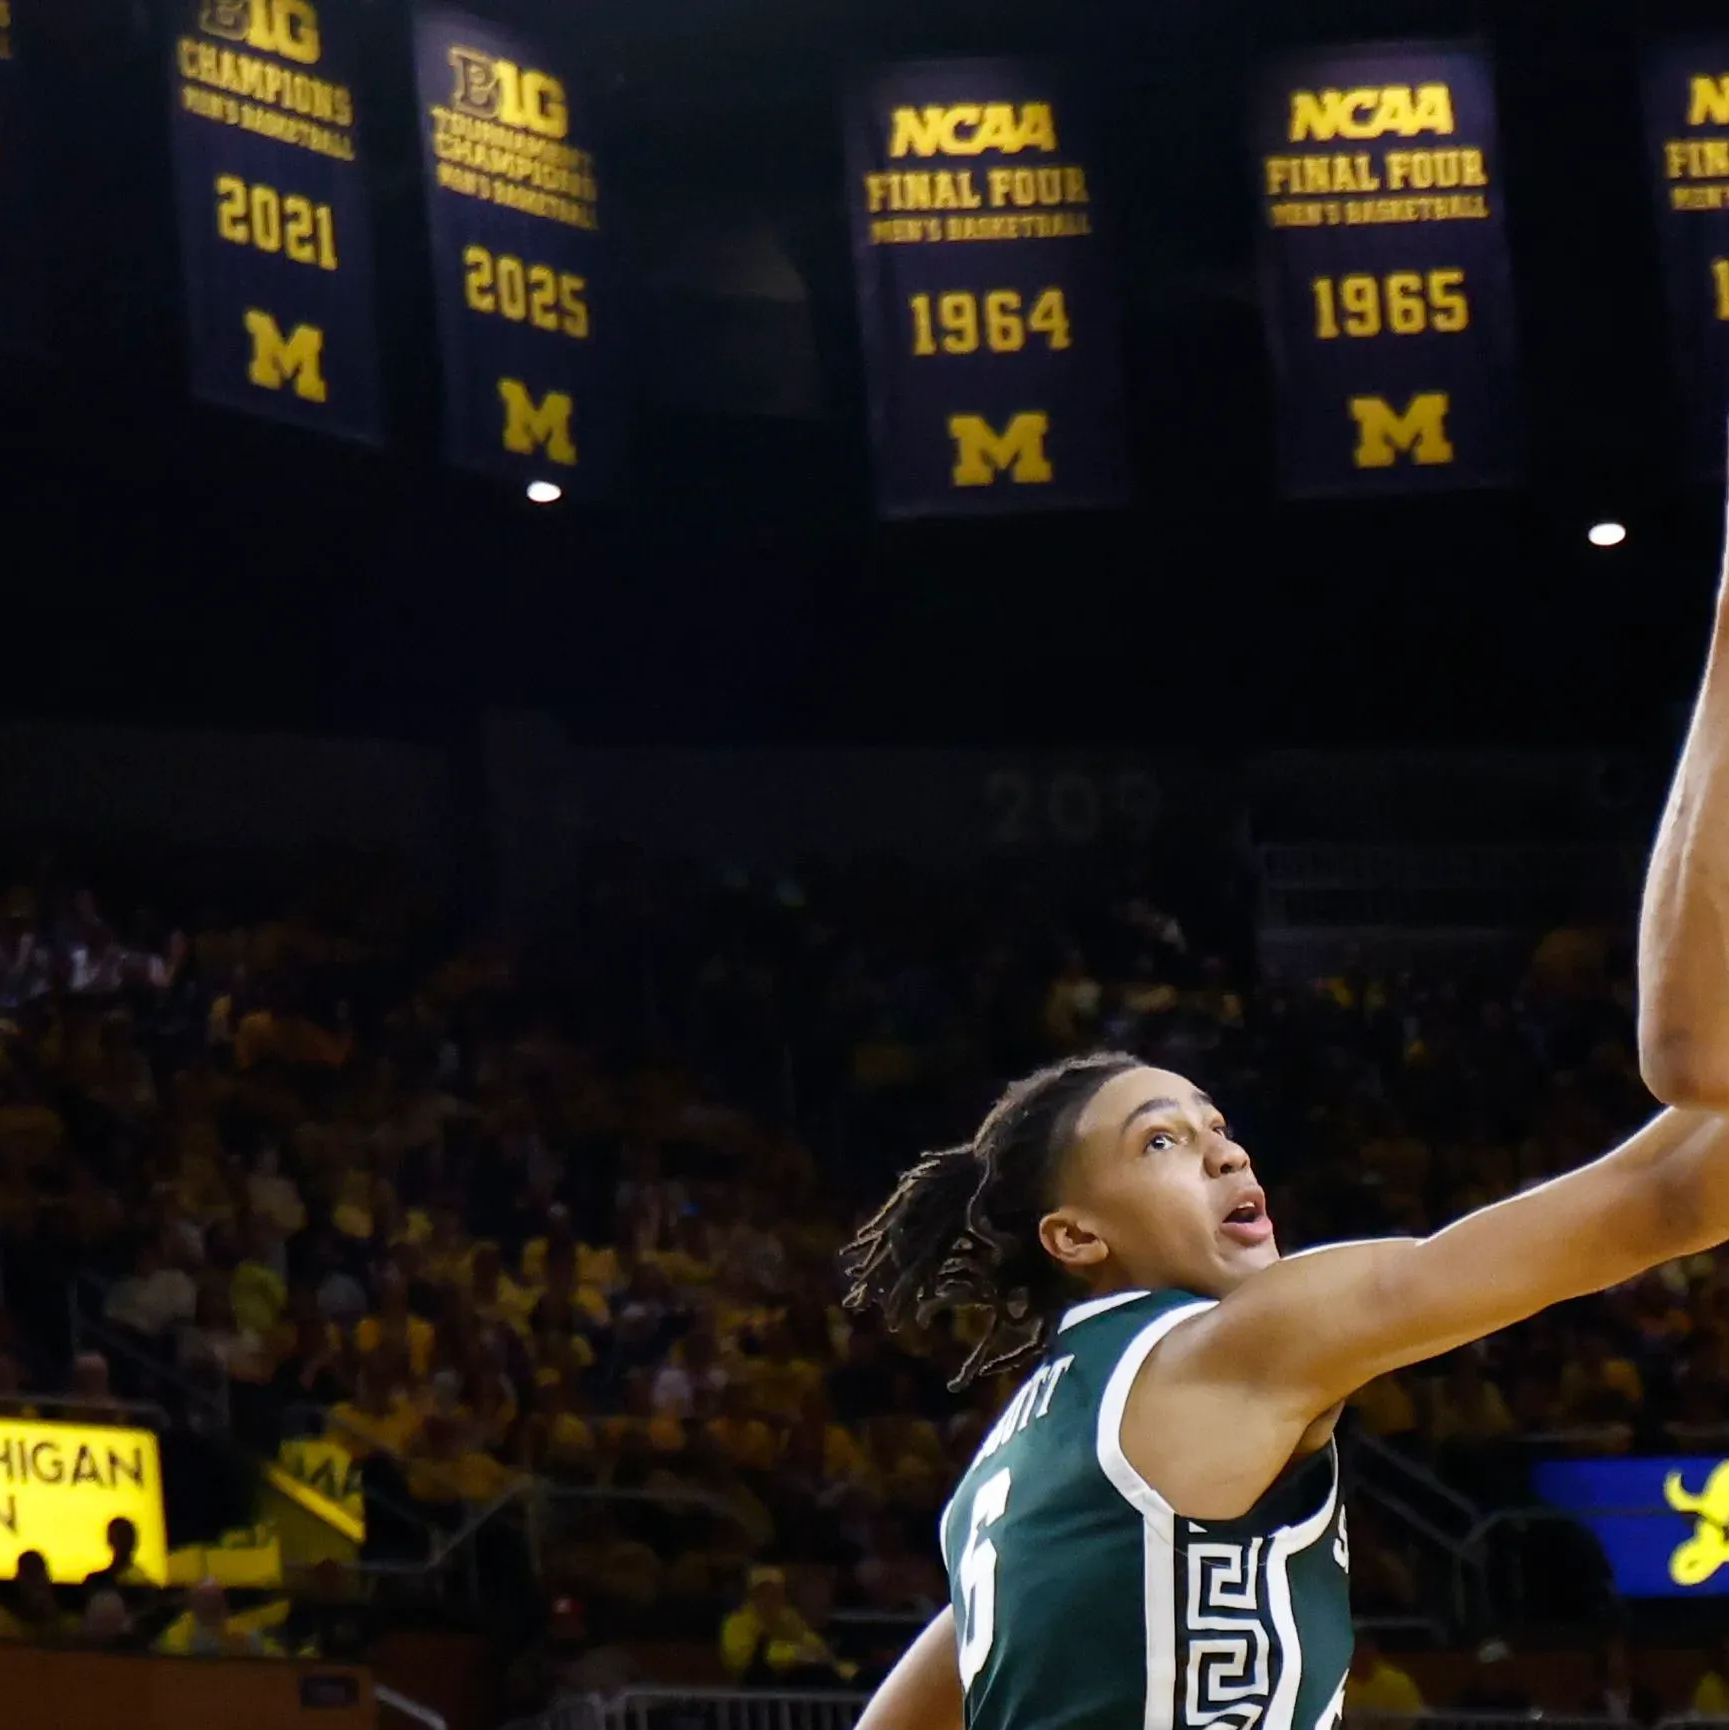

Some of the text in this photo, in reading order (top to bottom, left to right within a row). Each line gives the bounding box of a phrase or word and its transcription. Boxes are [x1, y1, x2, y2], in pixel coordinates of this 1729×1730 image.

[176, 35, 355, 129] CHAMPIONS
[1288, 82, 1457, 144] NCAA
[888, 102, 1058, 159] NCAA
[863, 163, 1091, 214] FINAL FOUR
[1264, 146, 1489, 196] FINAL FOUR
[213, 173, 339, 271] 2021
[870, 211, 1092, 246] MEN'S BASKETBALL
[1268, 194, 1491, 229] MEN'S BASKETBALL
[462, 243, 590, 341] 2025
[909, 285, 1073, 358] 1964
[1311, 266, 1471, 341] 1965
[242, 306, 327, 404] M
[495, 374, 578, 467] M
[946, 408, 1054, 489] M
[1348, 389, 1455, 470] M
[984, 764, 1163, 846] 209
